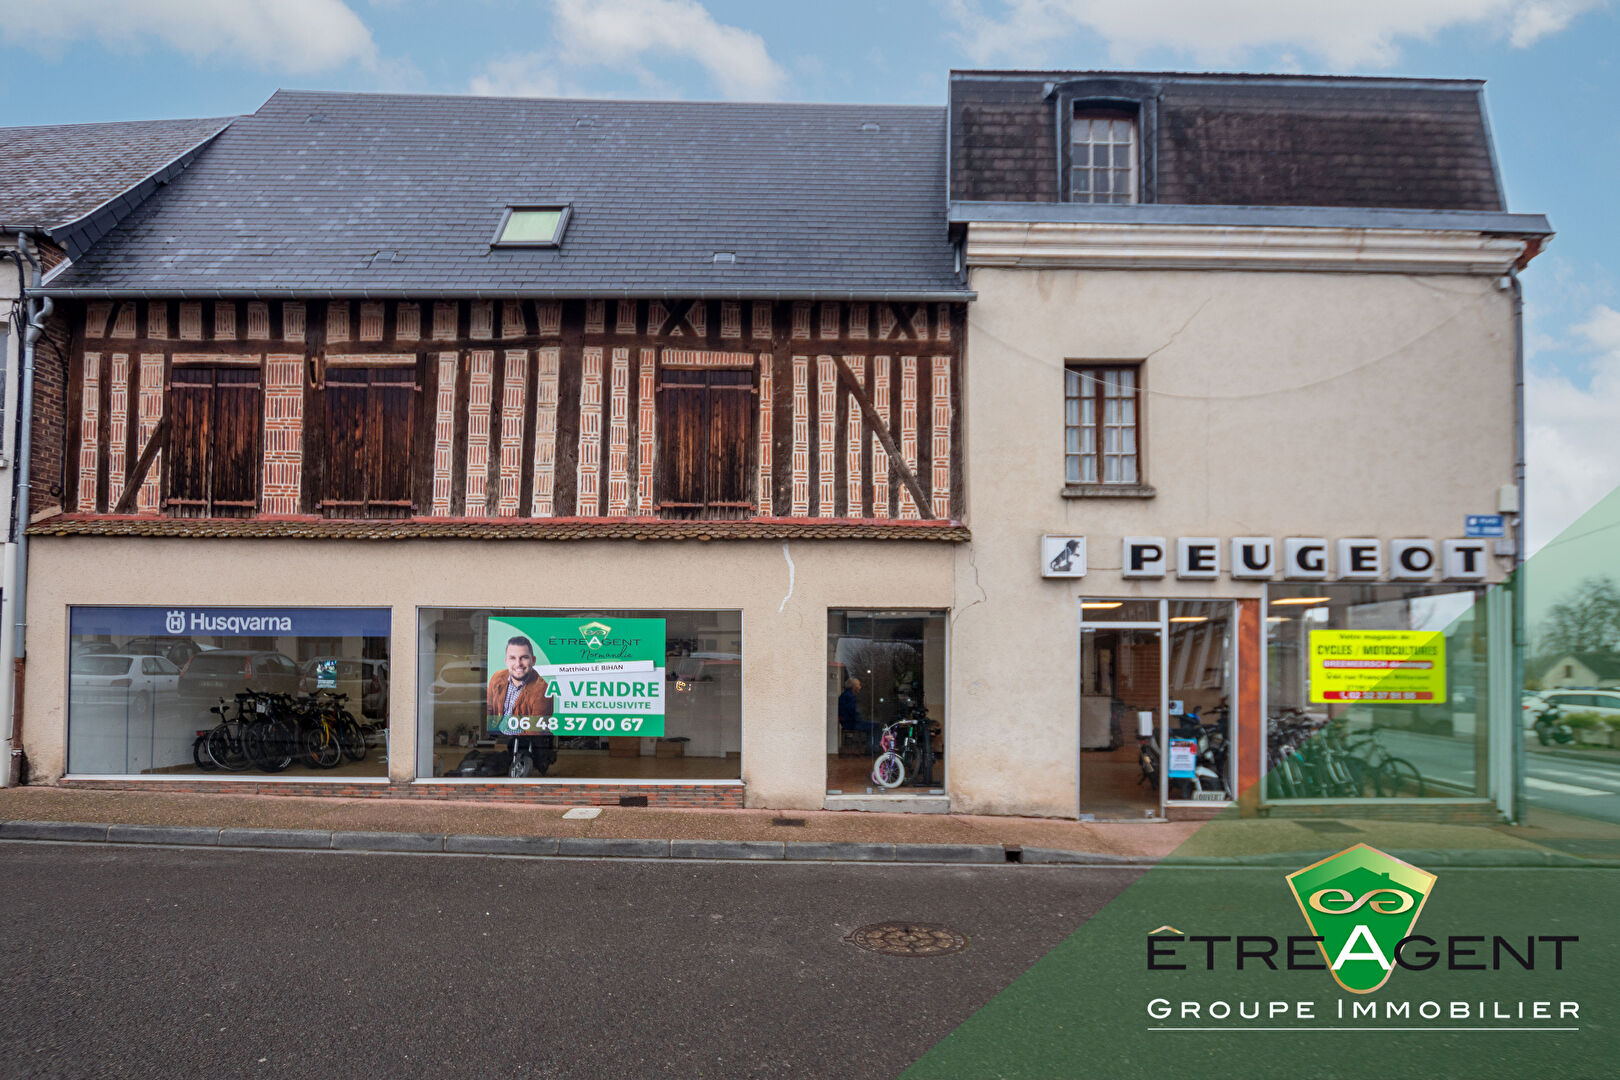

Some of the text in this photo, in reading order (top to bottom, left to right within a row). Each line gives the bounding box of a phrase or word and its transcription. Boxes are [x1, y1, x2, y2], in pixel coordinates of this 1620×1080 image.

[1130, 544, 1486, 573] PEUGEOT
[190, 612, 292, 634] Husqvarna
[580, 644, 633, 660] Normandie
[1317, 644, 1353, 656] CYCLES
[569, 681, 660, 698] VENDRE
[564, 700, 652, 710] EN EXCLUSIVITE
[507, 717, 644, 732] 06 48 37 00 67
